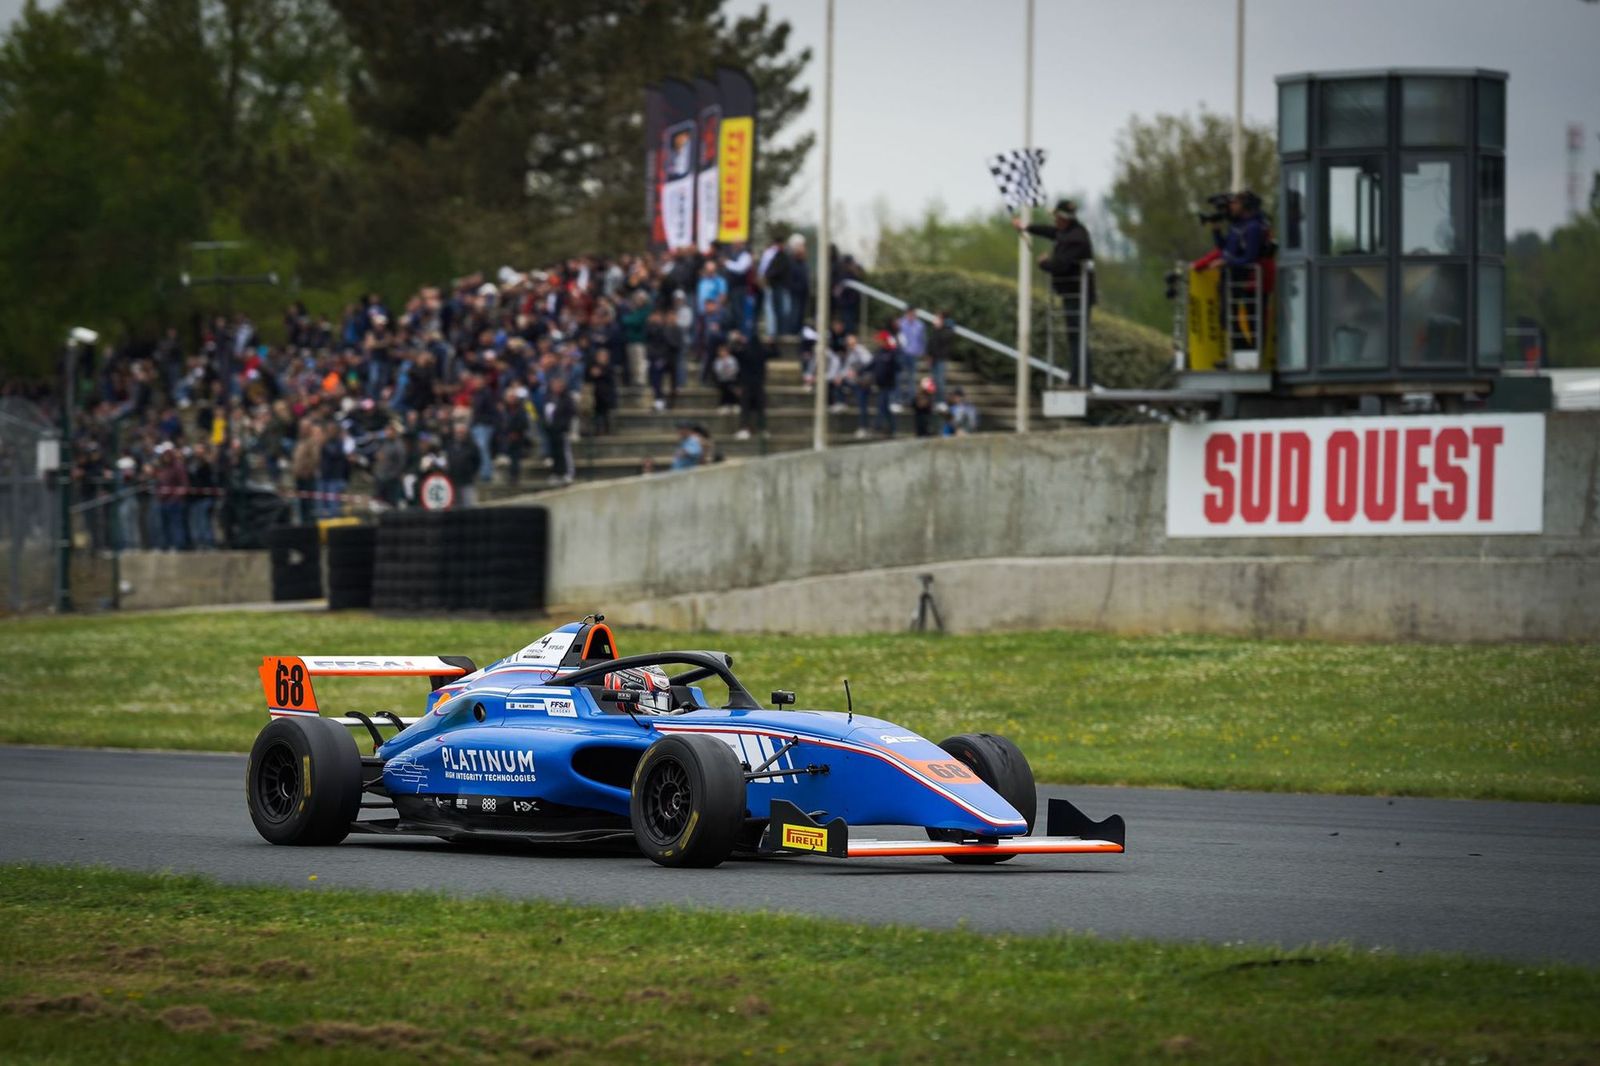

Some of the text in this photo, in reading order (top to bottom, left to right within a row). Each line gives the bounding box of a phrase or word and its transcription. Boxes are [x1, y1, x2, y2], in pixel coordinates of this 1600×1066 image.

[1203, 426, 1504, 525] SUD OUEST
[276, 662, 304, 707] 68
[441, 746, 535, 773] PLATINUM
[927, 763, 972, 779] 68
[445, 771, 536, 782] HIGH INTEGRITY TECHNOLOGIES
[786, 828, 824, 847] PIRELLI
